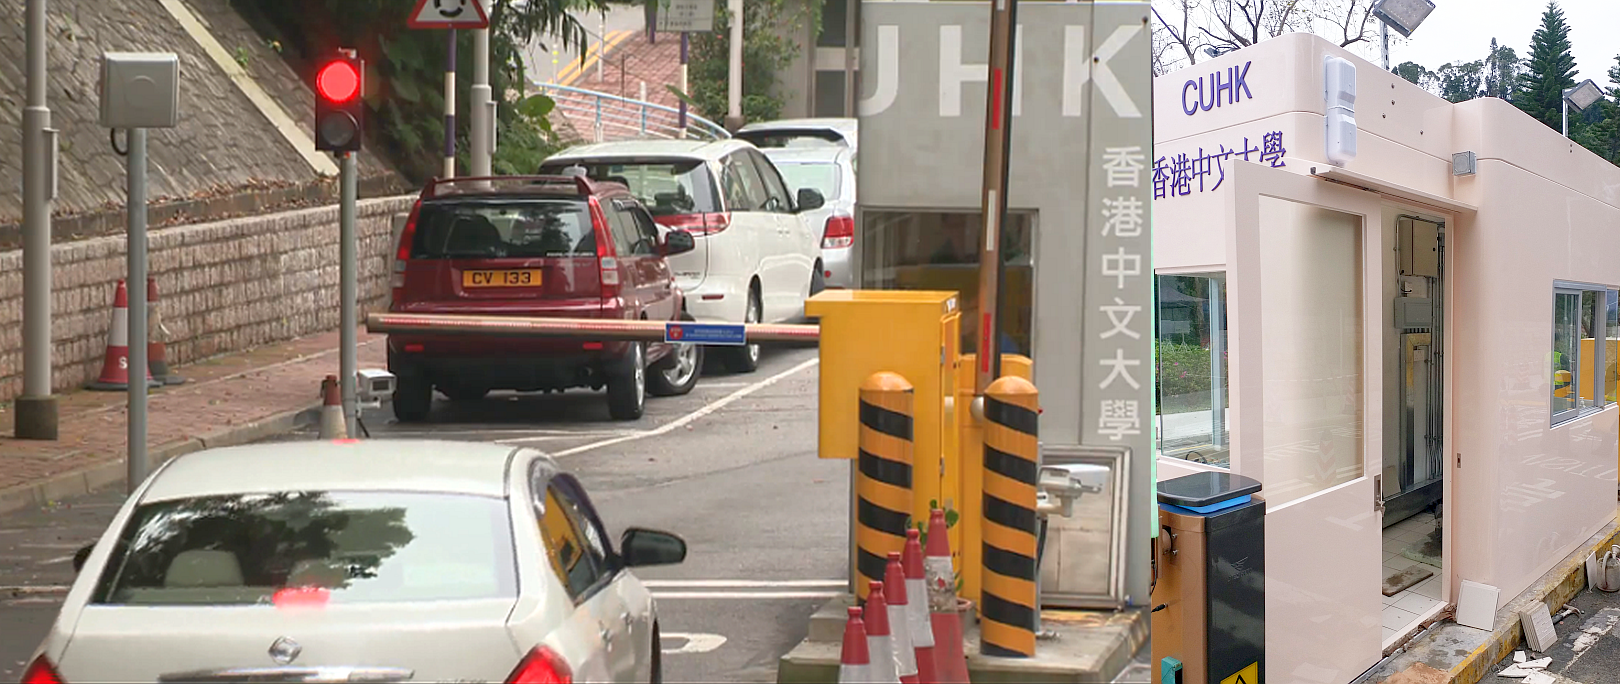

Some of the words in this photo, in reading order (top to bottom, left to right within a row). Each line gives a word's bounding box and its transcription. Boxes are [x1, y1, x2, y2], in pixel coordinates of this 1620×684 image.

[1181, 60, 1253, 116] CUHK
[472, 271, 493, 285] CV
[503, 271, 532, 285] 133
[1098, 146, 1145, 441] 香港中文大學
